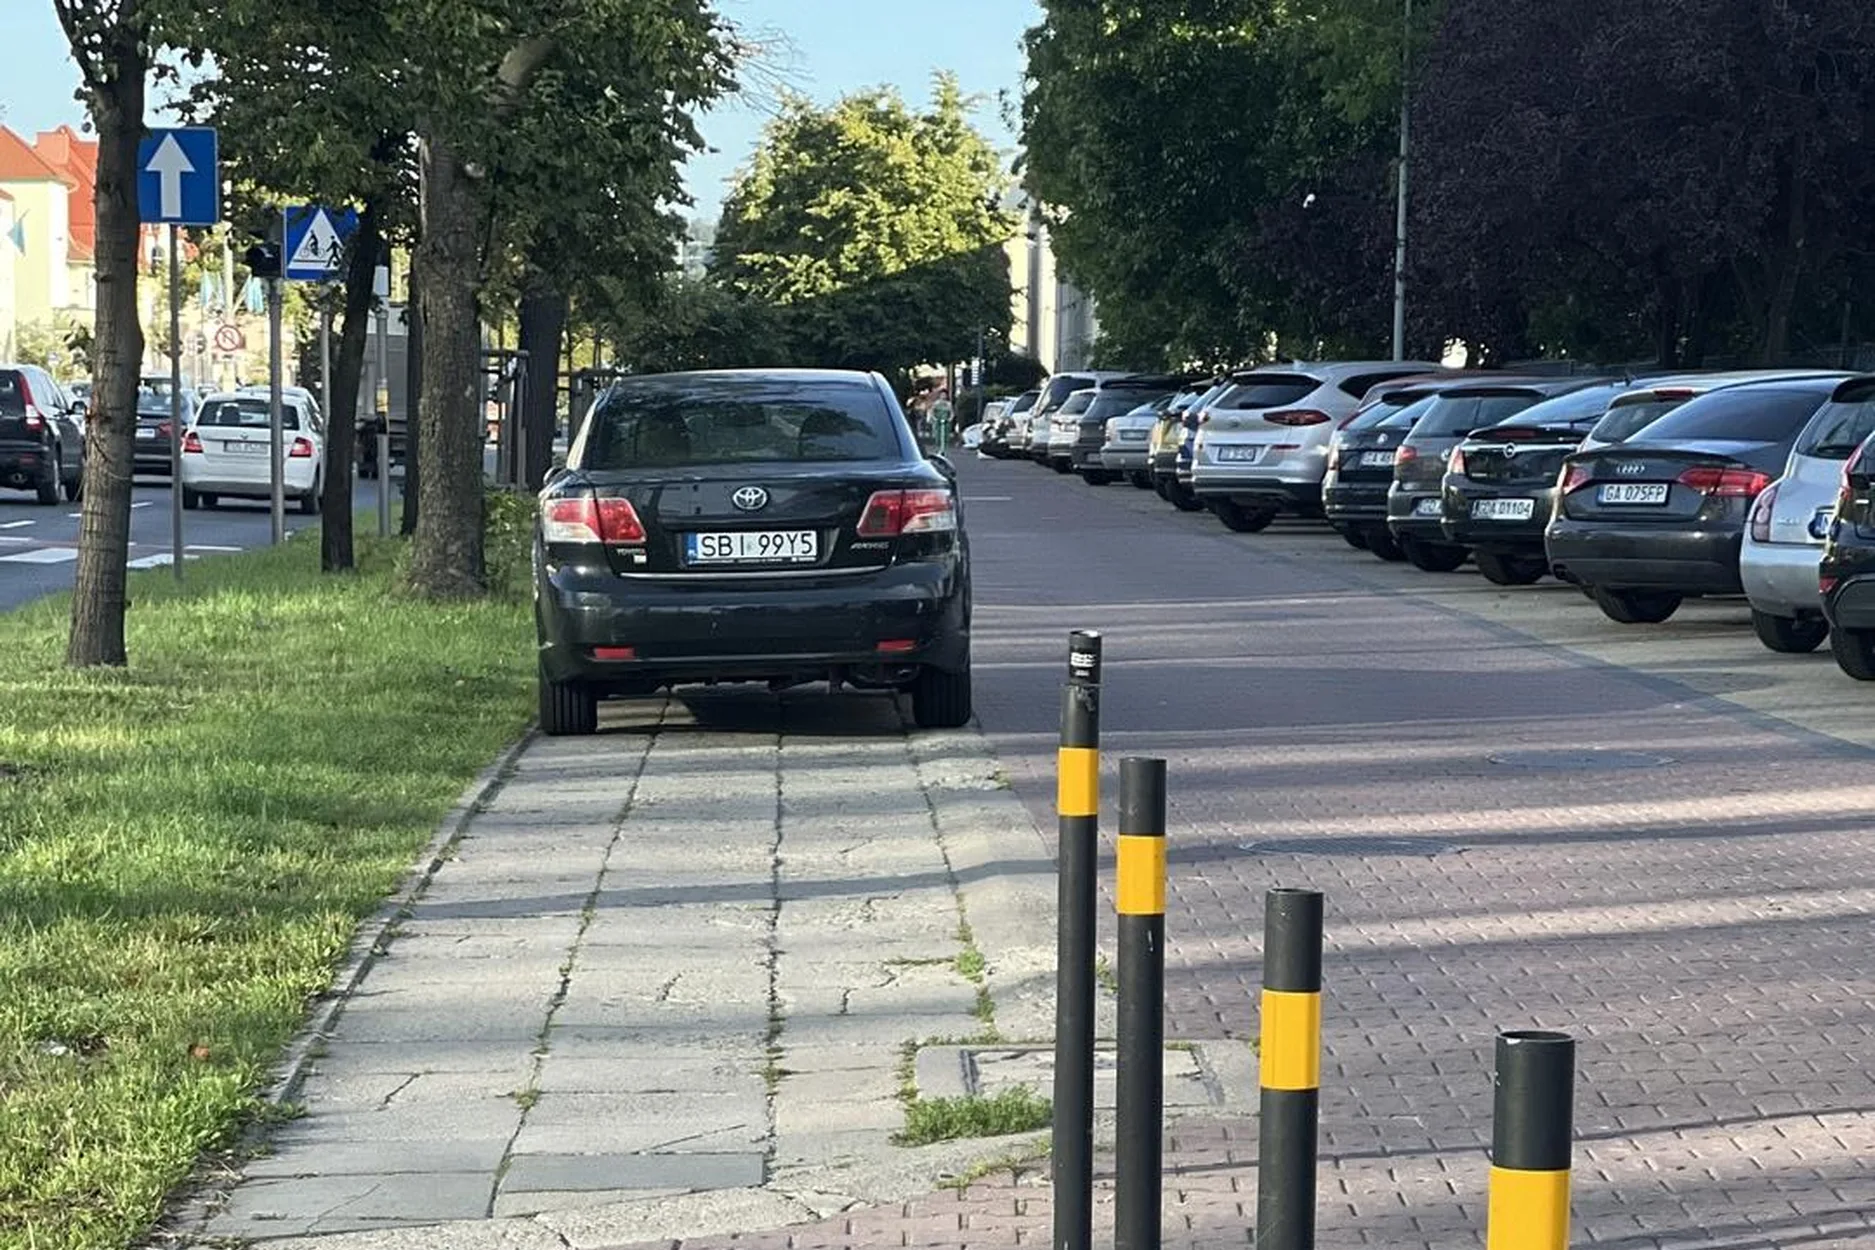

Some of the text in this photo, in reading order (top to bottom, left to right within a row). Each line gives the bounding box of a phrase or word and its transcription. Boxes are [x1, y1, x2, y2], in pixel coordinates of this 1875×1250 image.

[1605, 485, 1665, 501] GA 075FP
[757, 532, 813, 556] 99Y5
